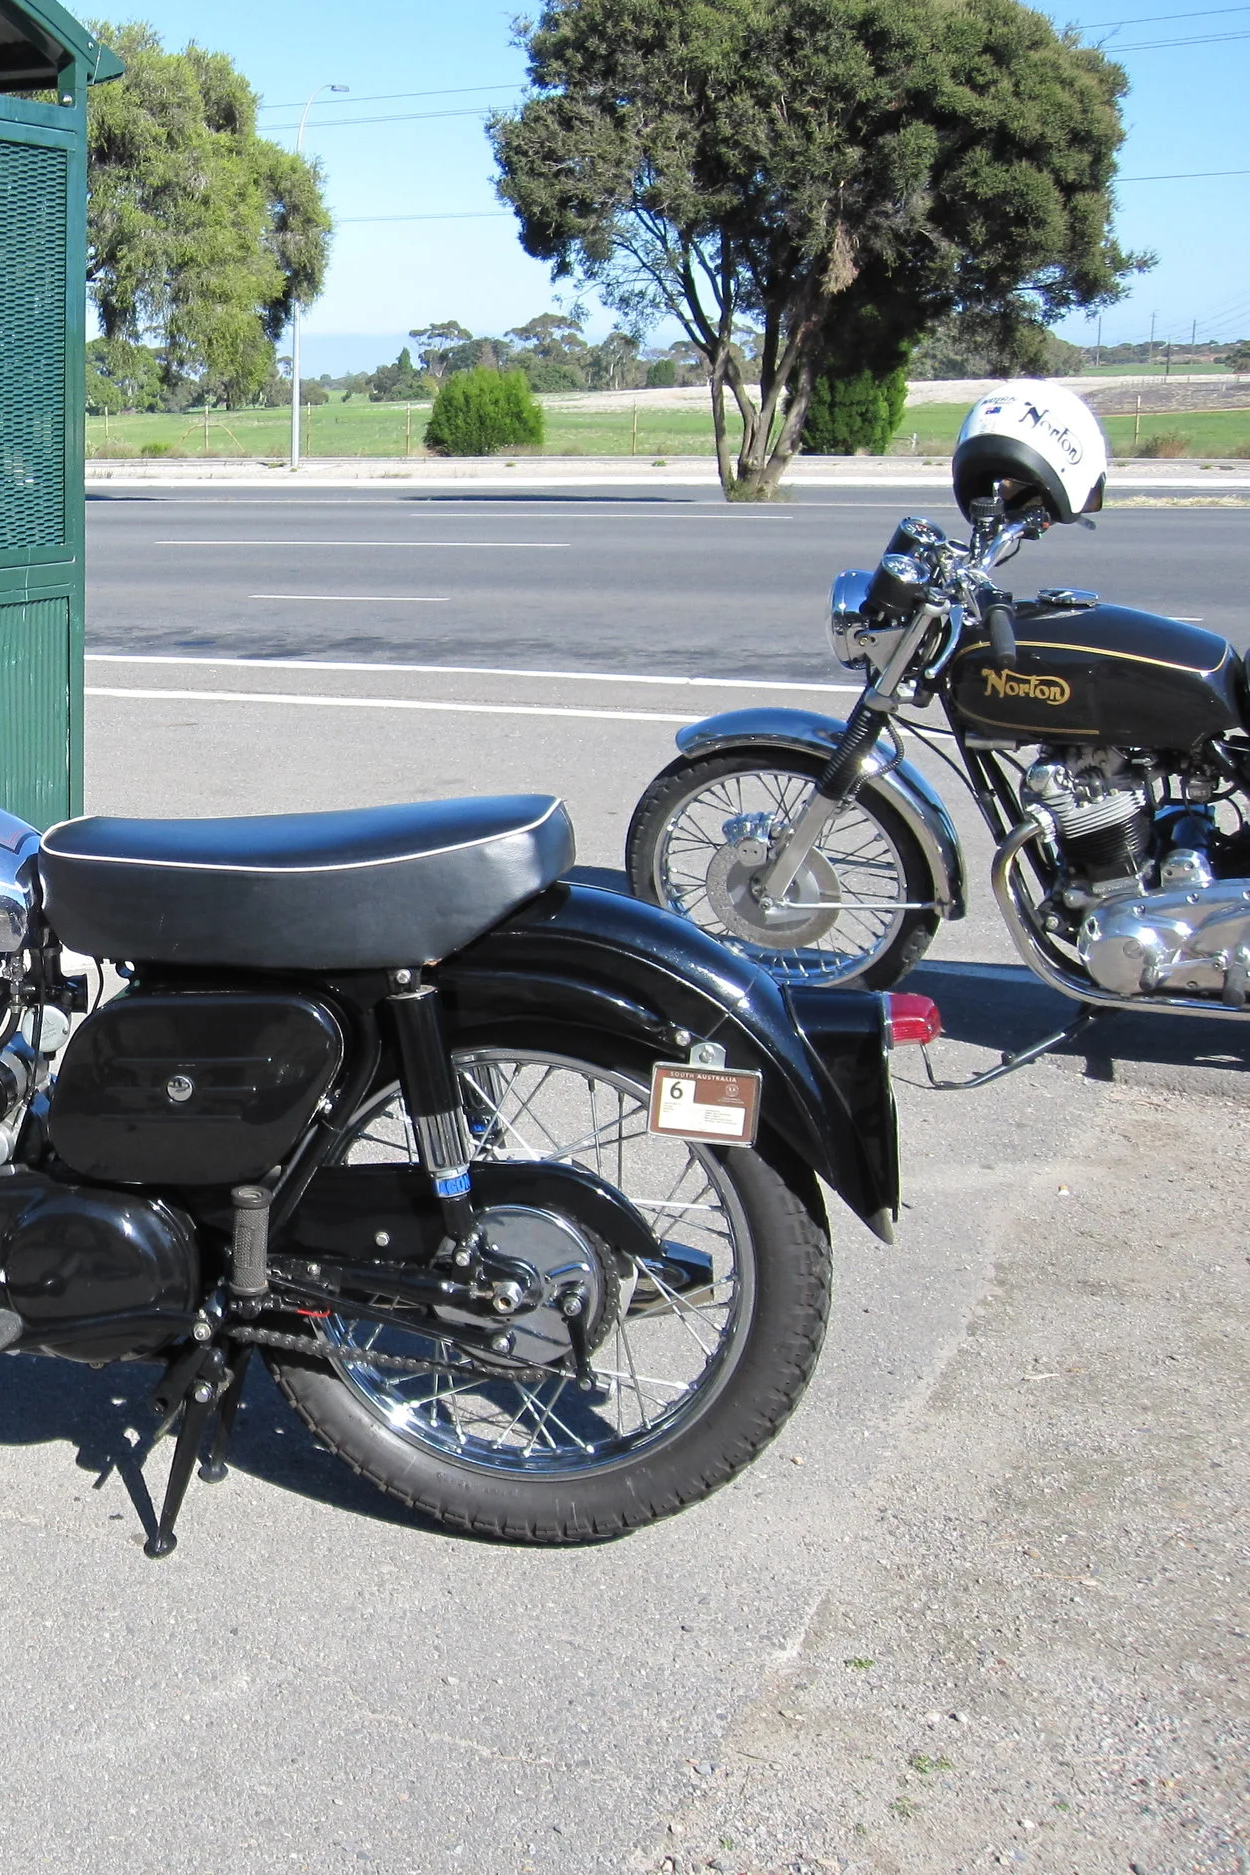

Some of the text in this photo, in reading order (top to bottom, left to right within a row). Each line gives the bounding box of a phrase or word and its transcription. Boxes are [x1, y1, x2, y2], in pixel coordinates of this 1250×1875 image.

[1018, 401, 1083, 465] Norton
[981, 668, 1071, 706] Norton
[670, 1071, 738, 1083] SOUTH AUSTRALIA
[670, 1080, 684, 1100] 6
